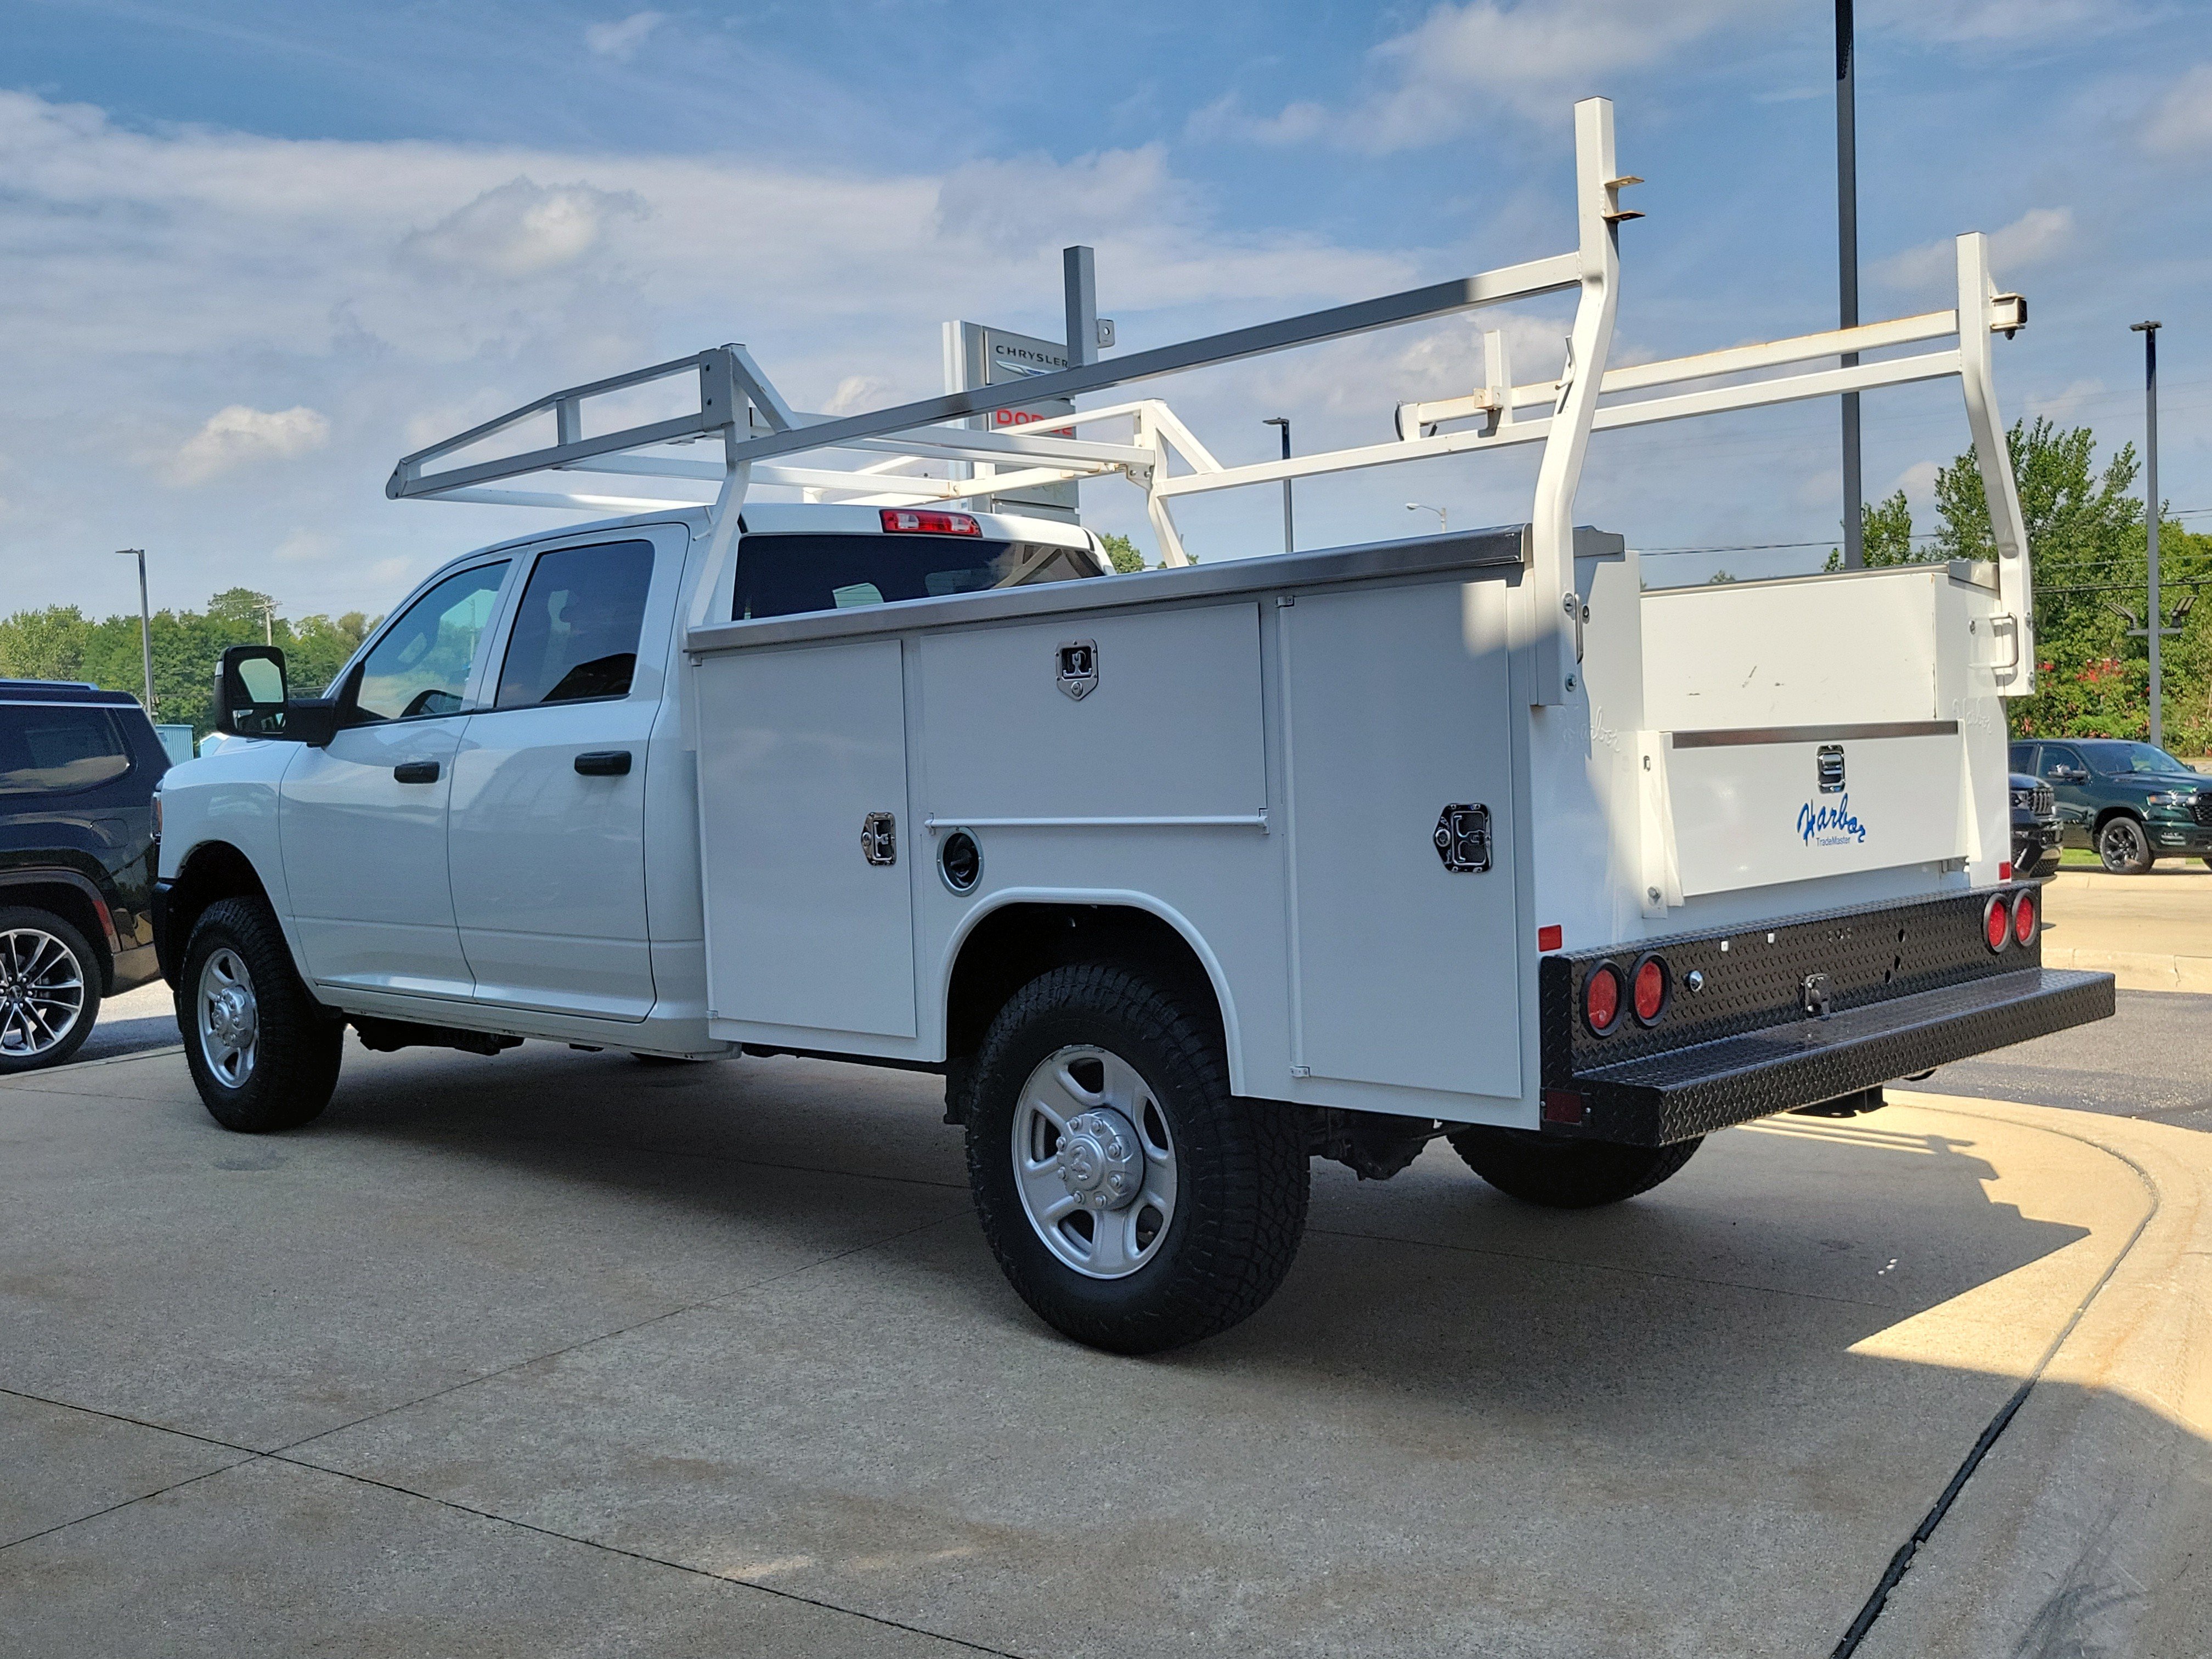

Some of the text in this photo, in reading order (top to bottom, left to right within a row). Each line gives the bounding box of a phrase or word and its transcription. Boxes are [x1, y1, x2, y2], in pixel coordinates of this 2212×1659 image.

[995, 345, 1068, 368] CHRYSLER
[996, 409, 1073, 436] DOE
[1796, 792, 1866, 847] Harbor
[1815, 836, 1851, 847] TradeMaster
